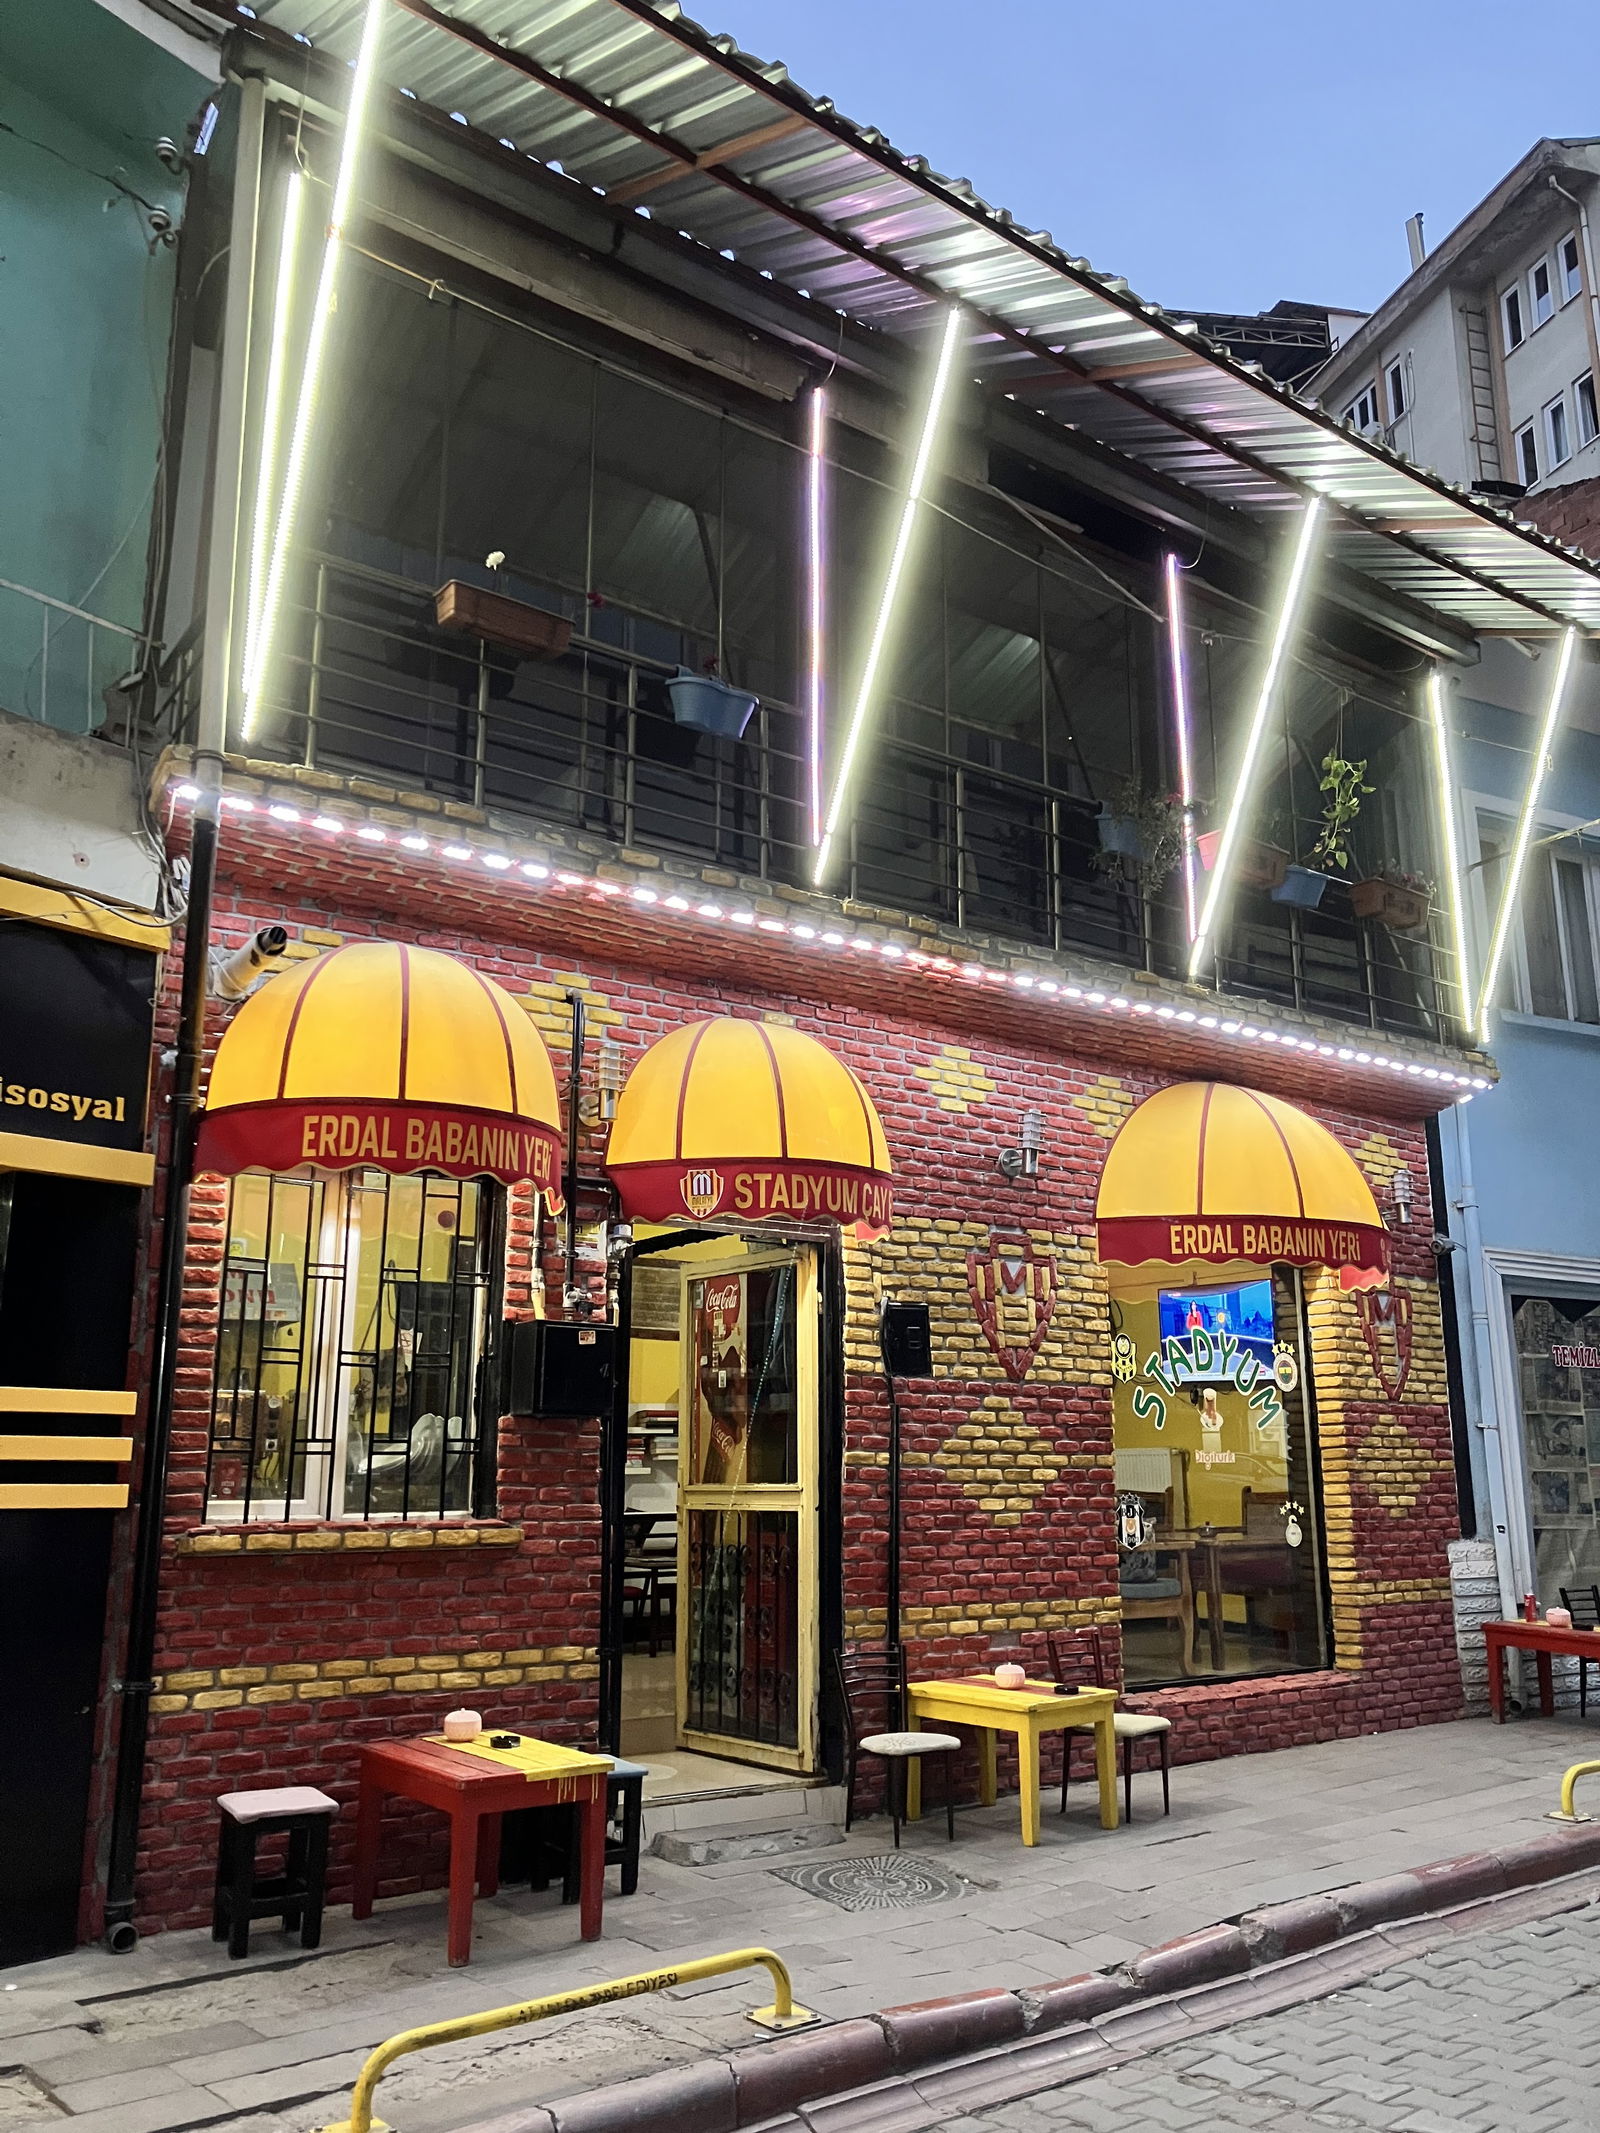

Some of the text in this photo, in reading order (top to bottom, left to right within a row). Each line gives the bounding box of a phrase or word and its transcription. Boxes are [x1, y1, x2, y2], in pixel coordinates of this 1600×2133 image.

[302, 1115, 398, 1159] ERDAL
[405, 1118, 521, 1171] BABANIN
[734, 1173, 858, 1215] STADYUM
[861, 1182, 888, 1221] ÇAY
[1170, 1224, 1239, 1255] ERDAL
[1243, 1225, 1326, 1258] BABANIN
[1133, 1326, 1283, 1430] STADYUM
